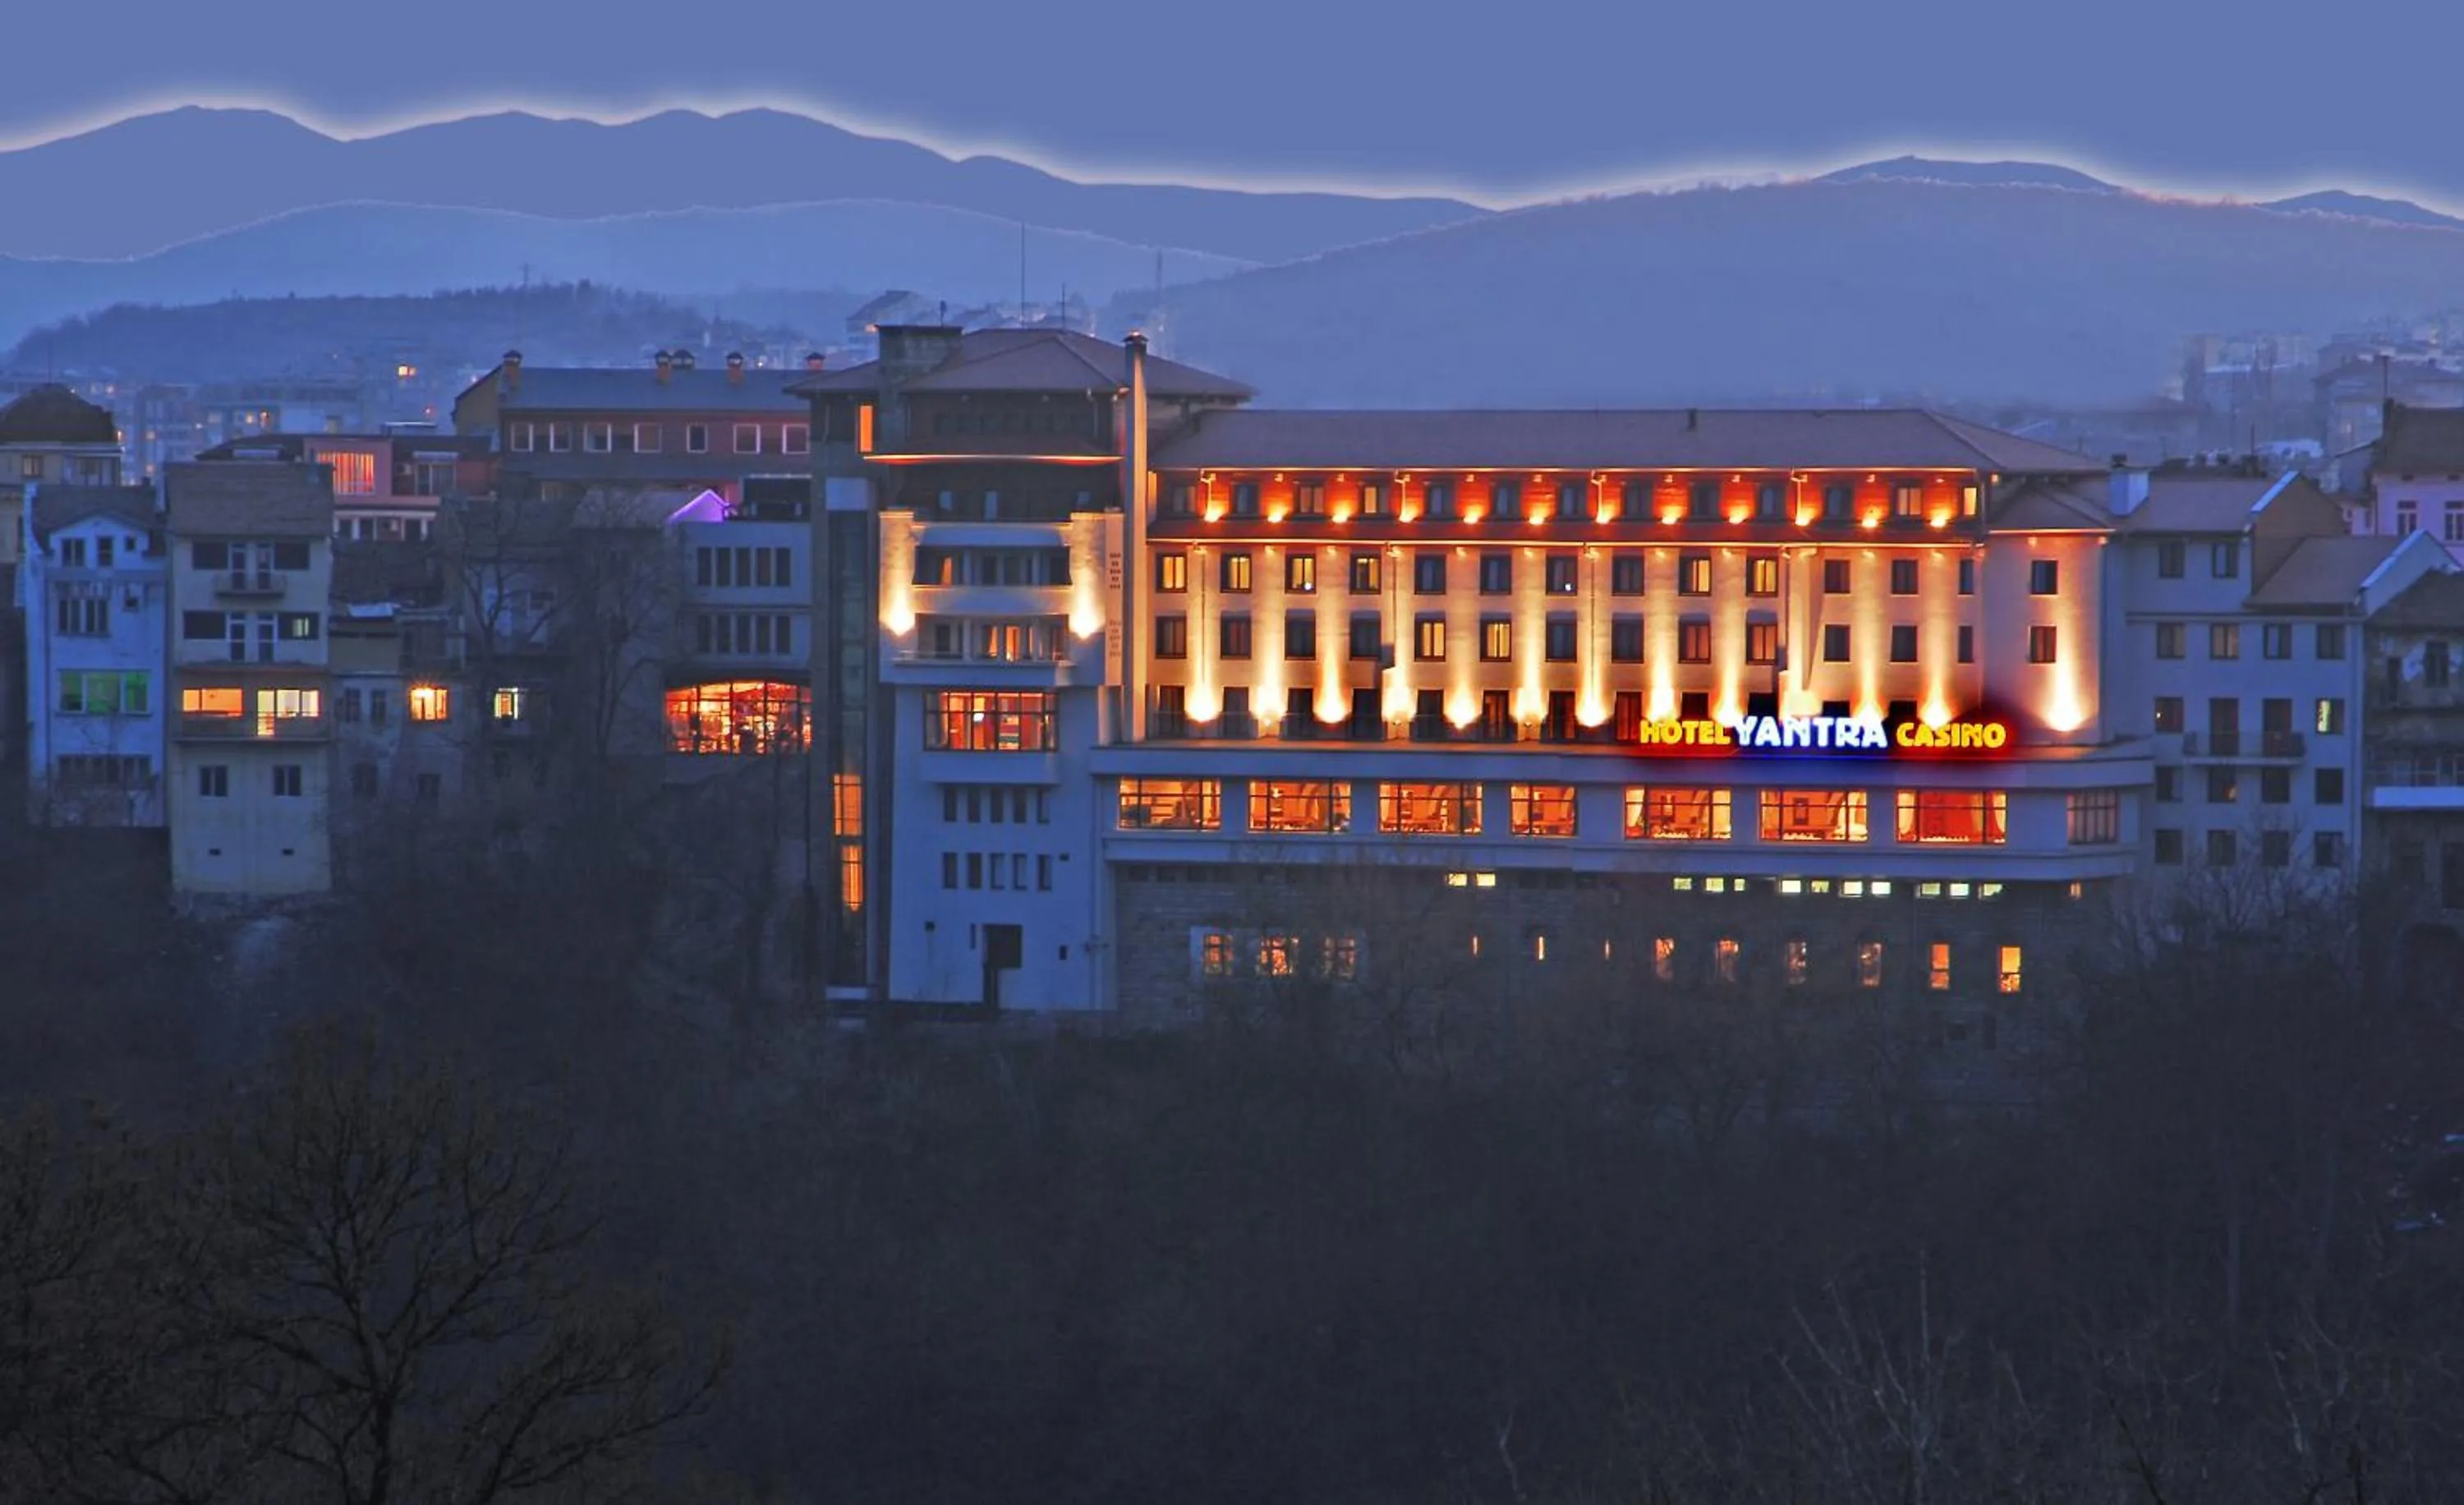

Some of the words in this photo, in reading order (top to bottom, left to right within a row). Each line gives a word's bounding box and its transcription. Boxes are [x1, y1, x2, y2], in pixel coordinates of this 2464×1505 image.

[1639, 719, 1731, 744] HOTEL
[1733, 716, 1887, 748] YANTRA
[1896, 721, 2007, 748] CASINO
